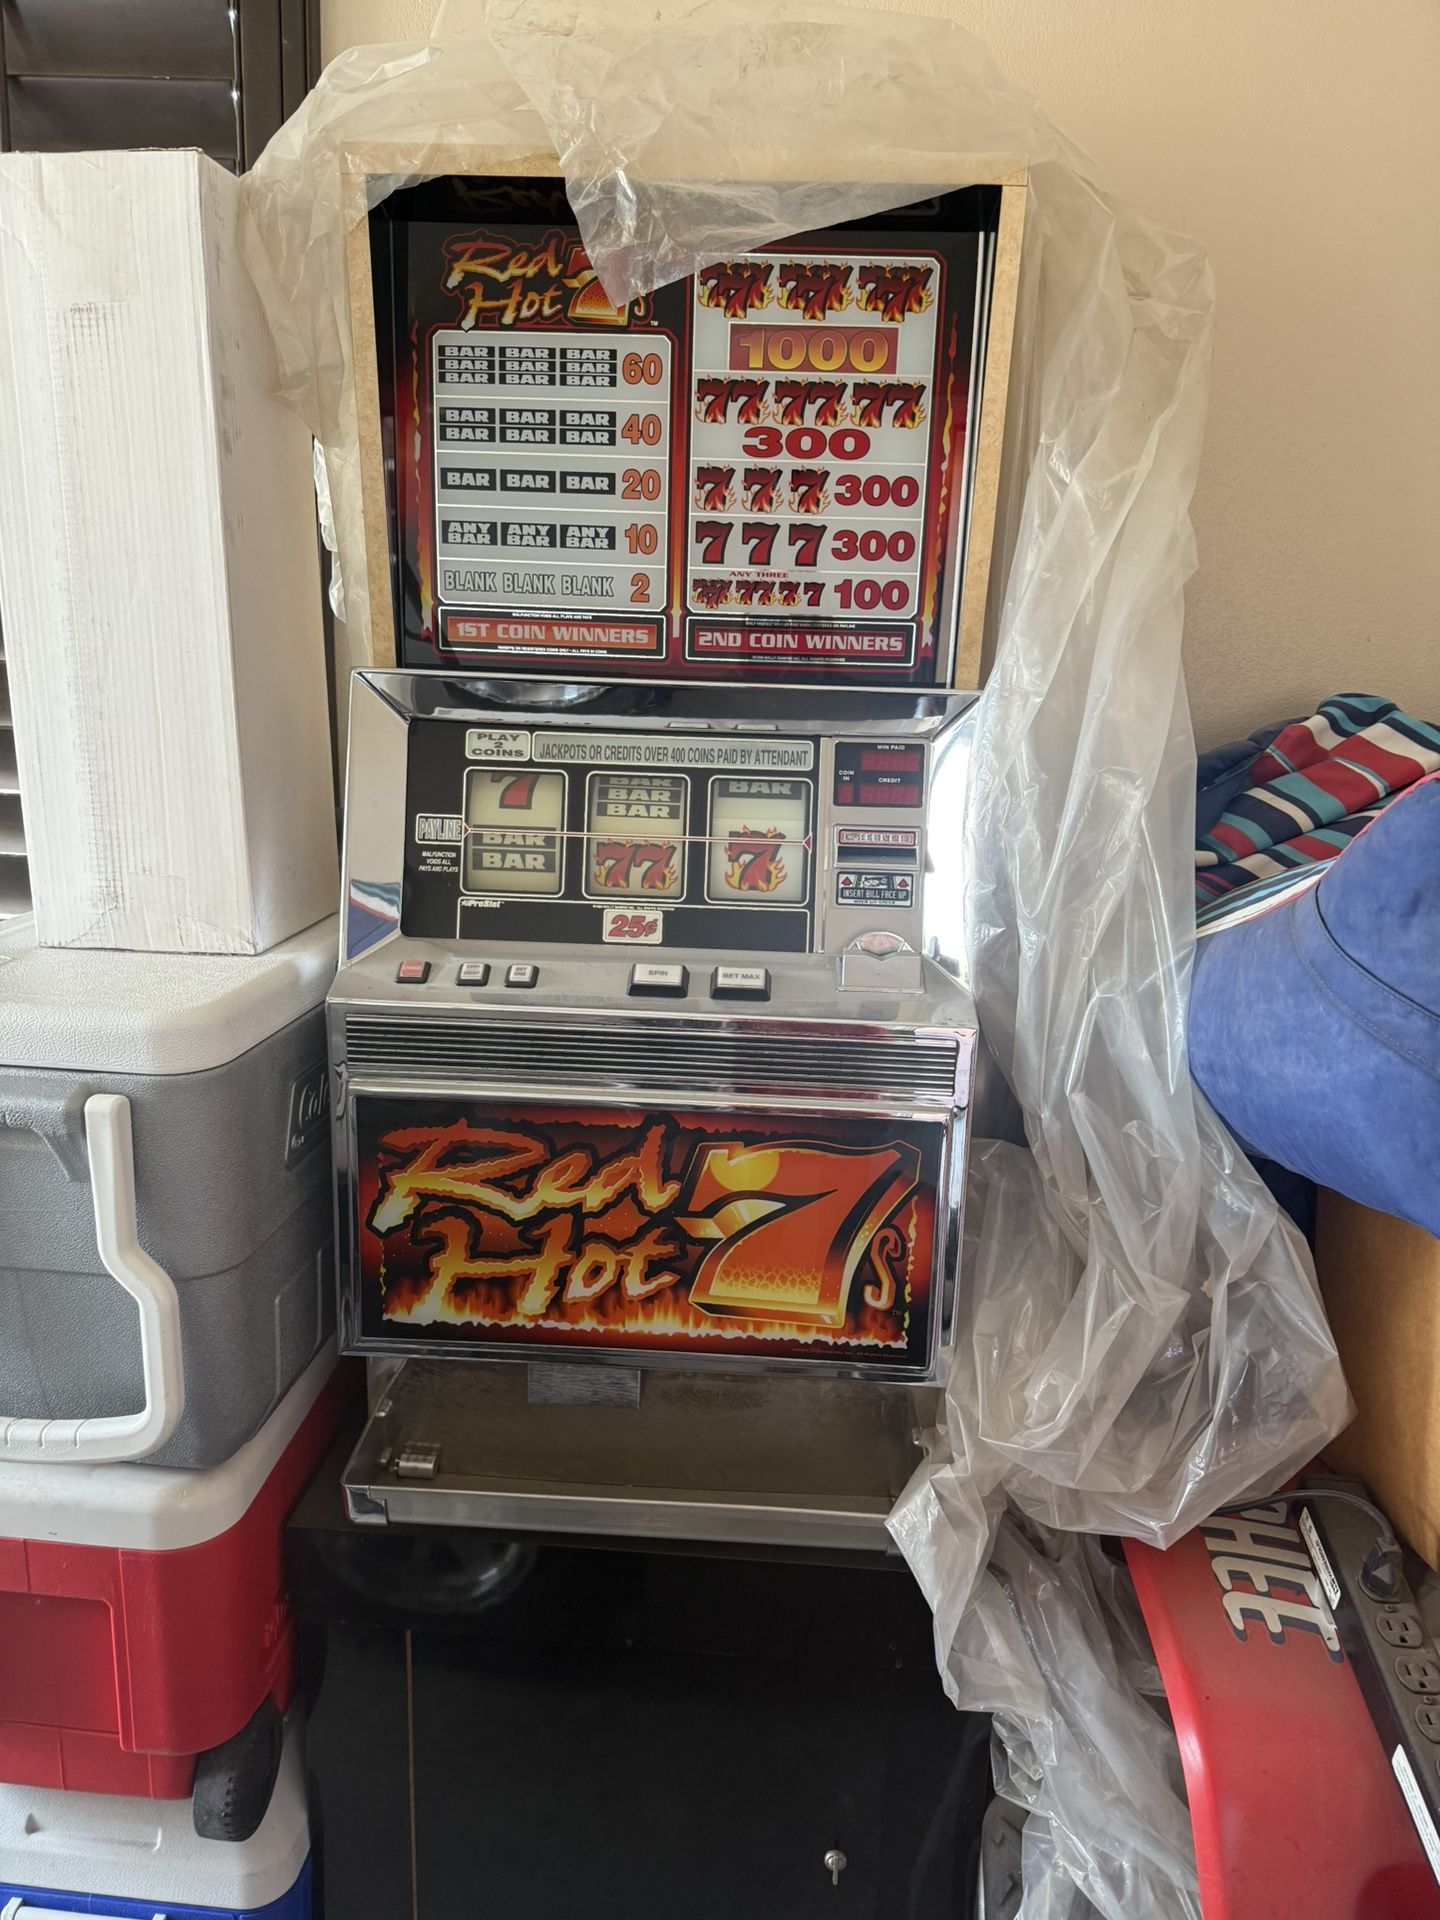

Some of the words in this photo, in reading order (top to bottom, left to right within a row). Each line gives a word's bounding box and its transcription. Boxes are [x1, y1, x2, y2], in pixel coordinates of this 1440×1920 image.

[446, 239, 562, 289] Red
[461, 280, 562, 330] Hot
[444, 346, 489, 357] BAR
[505, 348, 549, 359] BAR
[566, 349, 610, 360] BAR
[739, 328, 889, 372] 1000
[445, 360, 489, 370] BAR
[506, 361, 549, 371] BAR
[566, 362, 610, 373] BAR
[622, 353, 662, 385] 60
[445, 373, 489, 383] BAR
[506, 374, 549, 385] BAR
[566, 376, 610, 387] BAR
[445, 409, 489, 423] BAR
[506, 411, 549, 424] BAR
[566, 413, 610, 426] BAR
[621, 414, 662, 445] 40
[446, 427, 489, 440] BAR
[506, 429, 549, 442] BAR
[566, 430, 610, 444] BAR
[742, 426, 871, 460] 300
[447, 471, 490, 486] BAR
[506, 473, 549, 488] BAR
[566, 476, 609, 490] BAR
[621, 469, 661, 500] 20
[834, 474, 919, 507] 300
[448, 522, 490, 533] ANY
[507, 524, 549, 535] ANY
[566, 526, 609, 537] ANY
[625, 524, 657, 554] 10
[448, 533, 491, 545] BAR
[507, 535, 550, 547] BAR
[566, 537, 609, 549] BAR
[831, 529, 915, 562] 300
[444, 570, 497, 592] BLANK
[503, 573, 555, 594] BLANK
[561, 575, 614, 597] BLANK
[630, 573, 650, 602] 2
[729, 570, 754, 578] ANY
[760, 571, 789, 579] THREE
[834, 579, 909, 610] 100
[456, 622, 490, 637] 1ST
[496, 624, 546, 639] COIN
[553, 627, 649, 644] WINNERS
[699, 632, 742, 647] 2ND
[749, 634, 798, 649] COIN
[806, 635, 903, 651] WINNERS
[477, 733, 520, 742] PLAY
[472, 748, 524, 757] COINS
[539, 743, 587, 760] JACKPOTS
[589, 744, 602, 760] OR
[604, 745, 642, 761] CREDITS
[645, 746, 668, 762] OVER
[671, 747, 685, 763] 400
[688, 748, 715, 763] COINS
[717, 749, 738, 764] PAID
[740, 749, 752, 764] BY
[753, 750, 808, 766] ATTENDANT
[608, 788, 671, 801] BAR
[606, 803, 670, 818] BAR
[418, 818, 462, 840] PAYLINE
[482, 852, 546, 870] BAR
[842, 888, 864, 898] INSERT
[866, 889, 880, 898] BILL
[881, 890, 897, 899] FACE
[898, 890, 907, 899] UP
[608, 914, 658, 938] 25¢
[371, 1119, 681, 1233] Red
[404, 1212, 681, 1323] Hot
